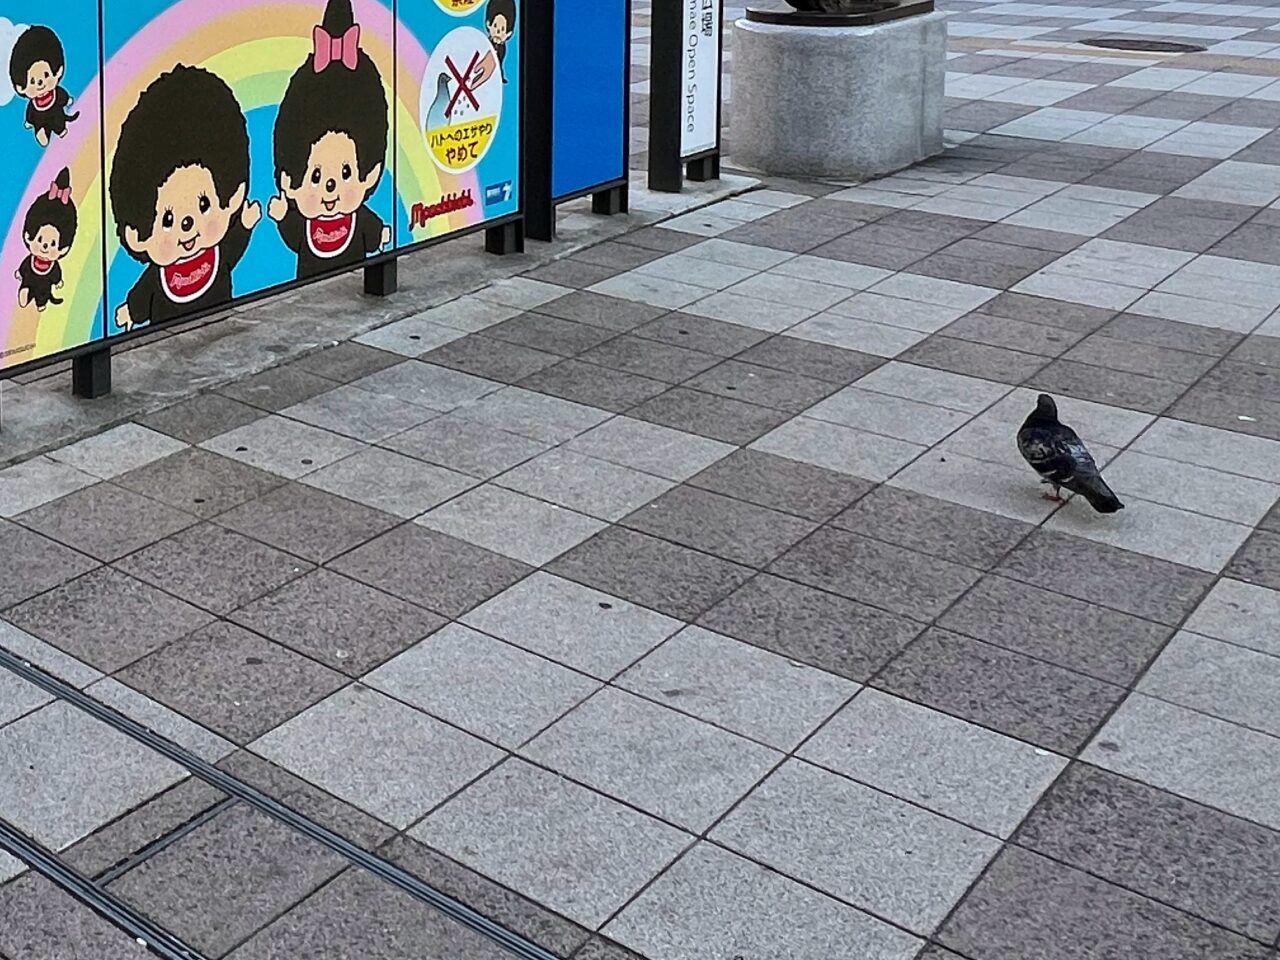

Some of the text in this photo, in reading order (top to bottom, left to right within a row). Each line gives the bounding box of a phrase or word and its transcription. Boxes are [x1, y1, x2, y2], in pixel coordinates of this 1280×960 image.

[687, 33, 699, 81] Open
[686, 83, 698, 133] Space
[431, 122, 493, 149] ハトへのエサやり
[445, 140, 479, 165] やめて
